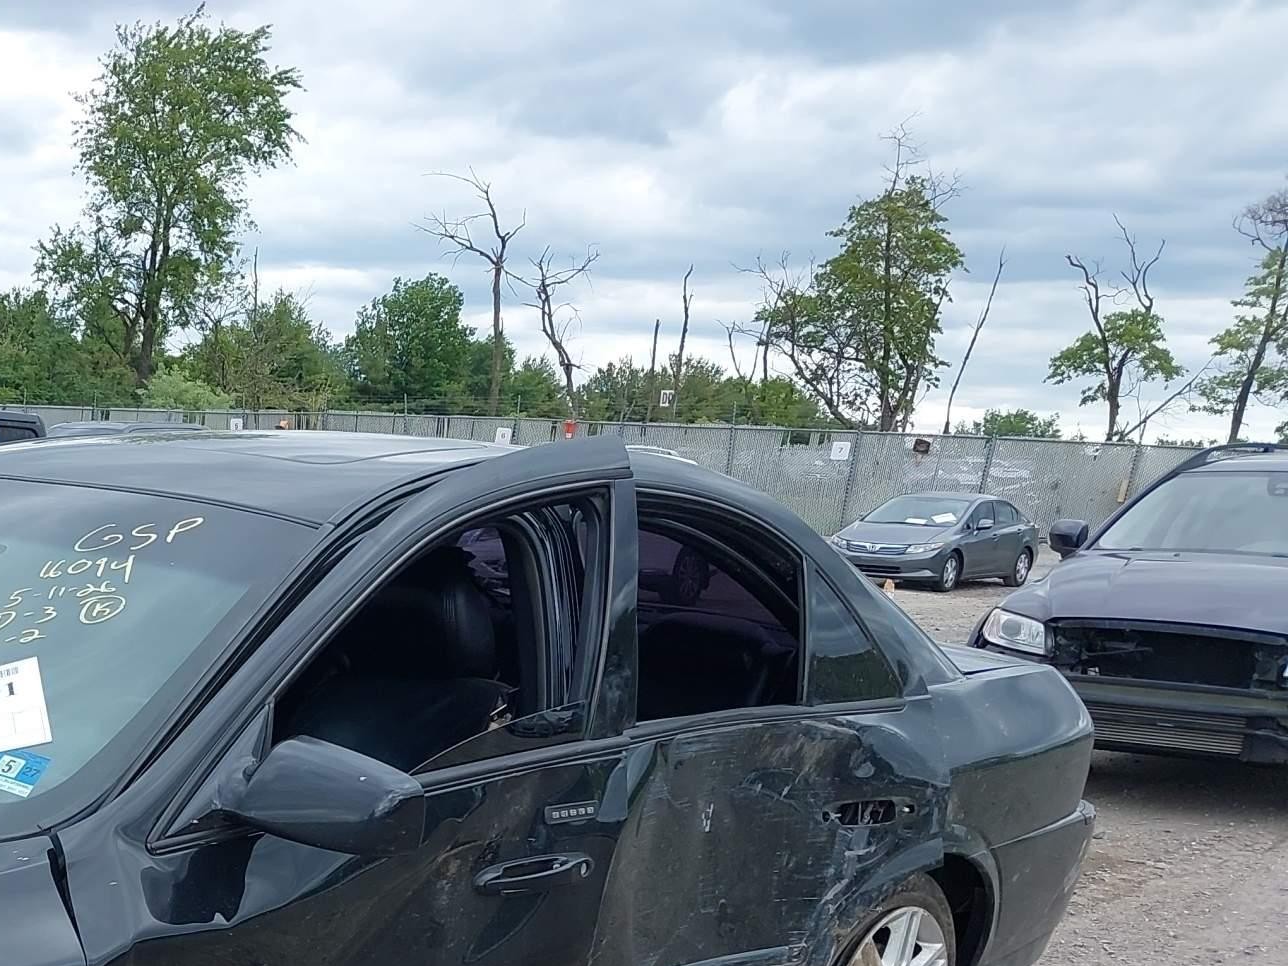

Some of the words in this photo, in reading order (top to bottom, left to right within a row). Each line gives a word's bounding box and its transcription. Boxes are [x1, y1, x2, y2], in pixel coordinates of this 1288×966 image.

[73, 516, 205, 552] GSP
[1, 759, 17, 774] 5
[23, 766, 41, 778] 27
